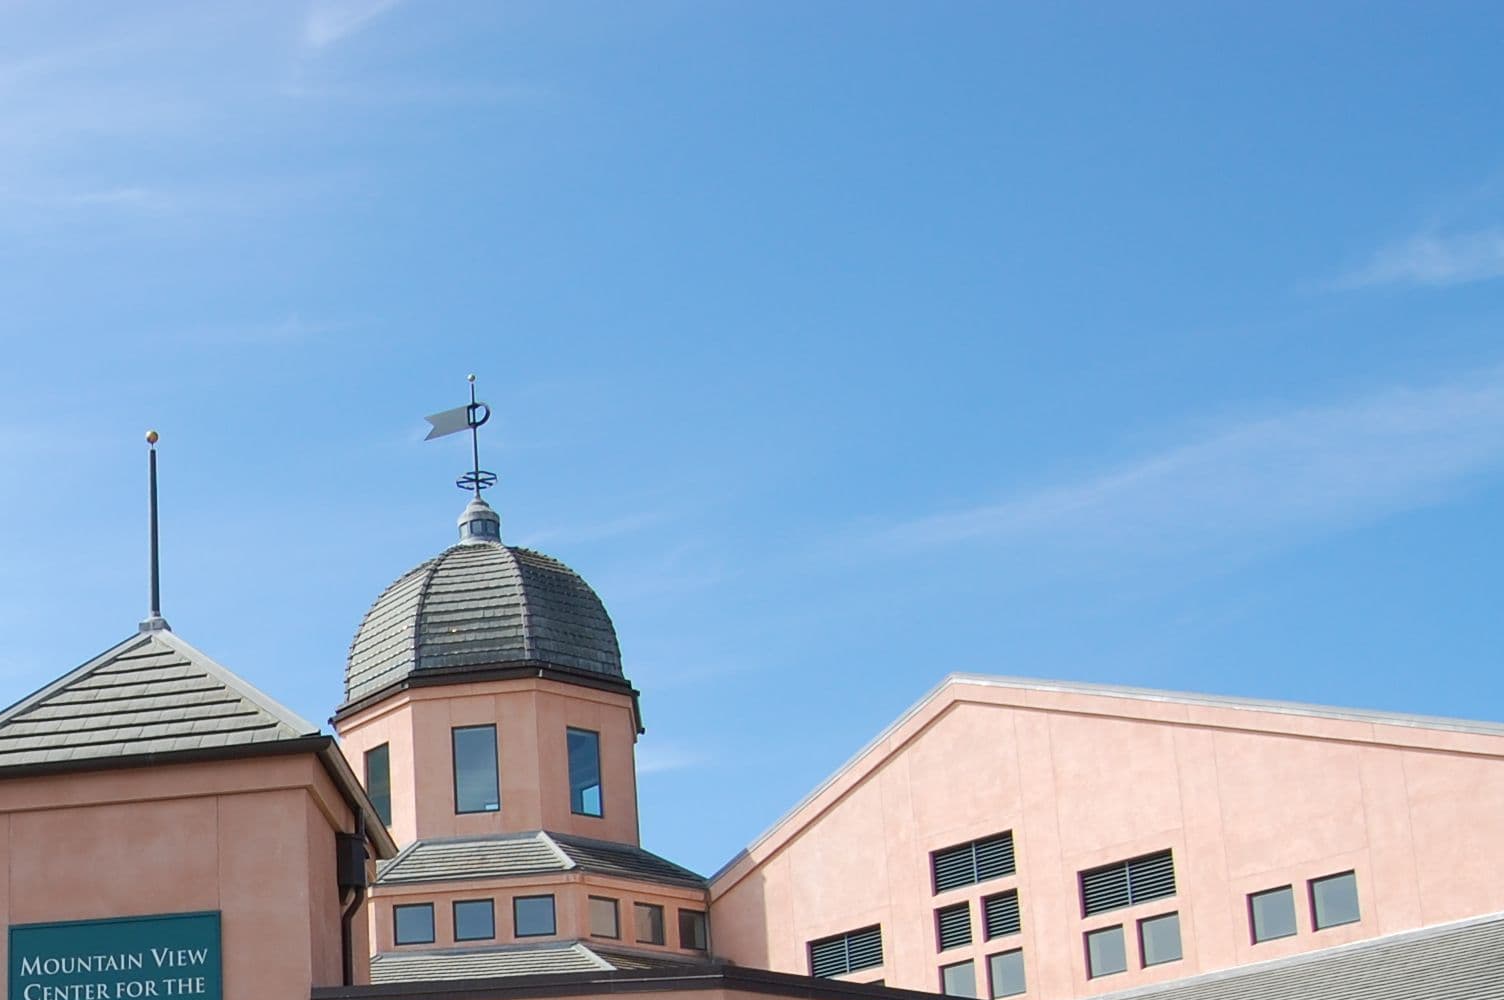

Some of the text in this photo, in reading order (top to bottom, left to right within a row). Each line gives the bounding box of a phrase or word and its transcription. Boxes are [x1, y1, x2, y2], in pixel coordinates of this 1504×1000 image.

[20, 948, 208, 977] MOUNTAIN VIEW
[116, 980, 159, 999] FOR
[163, 977, 205, 994] THE
